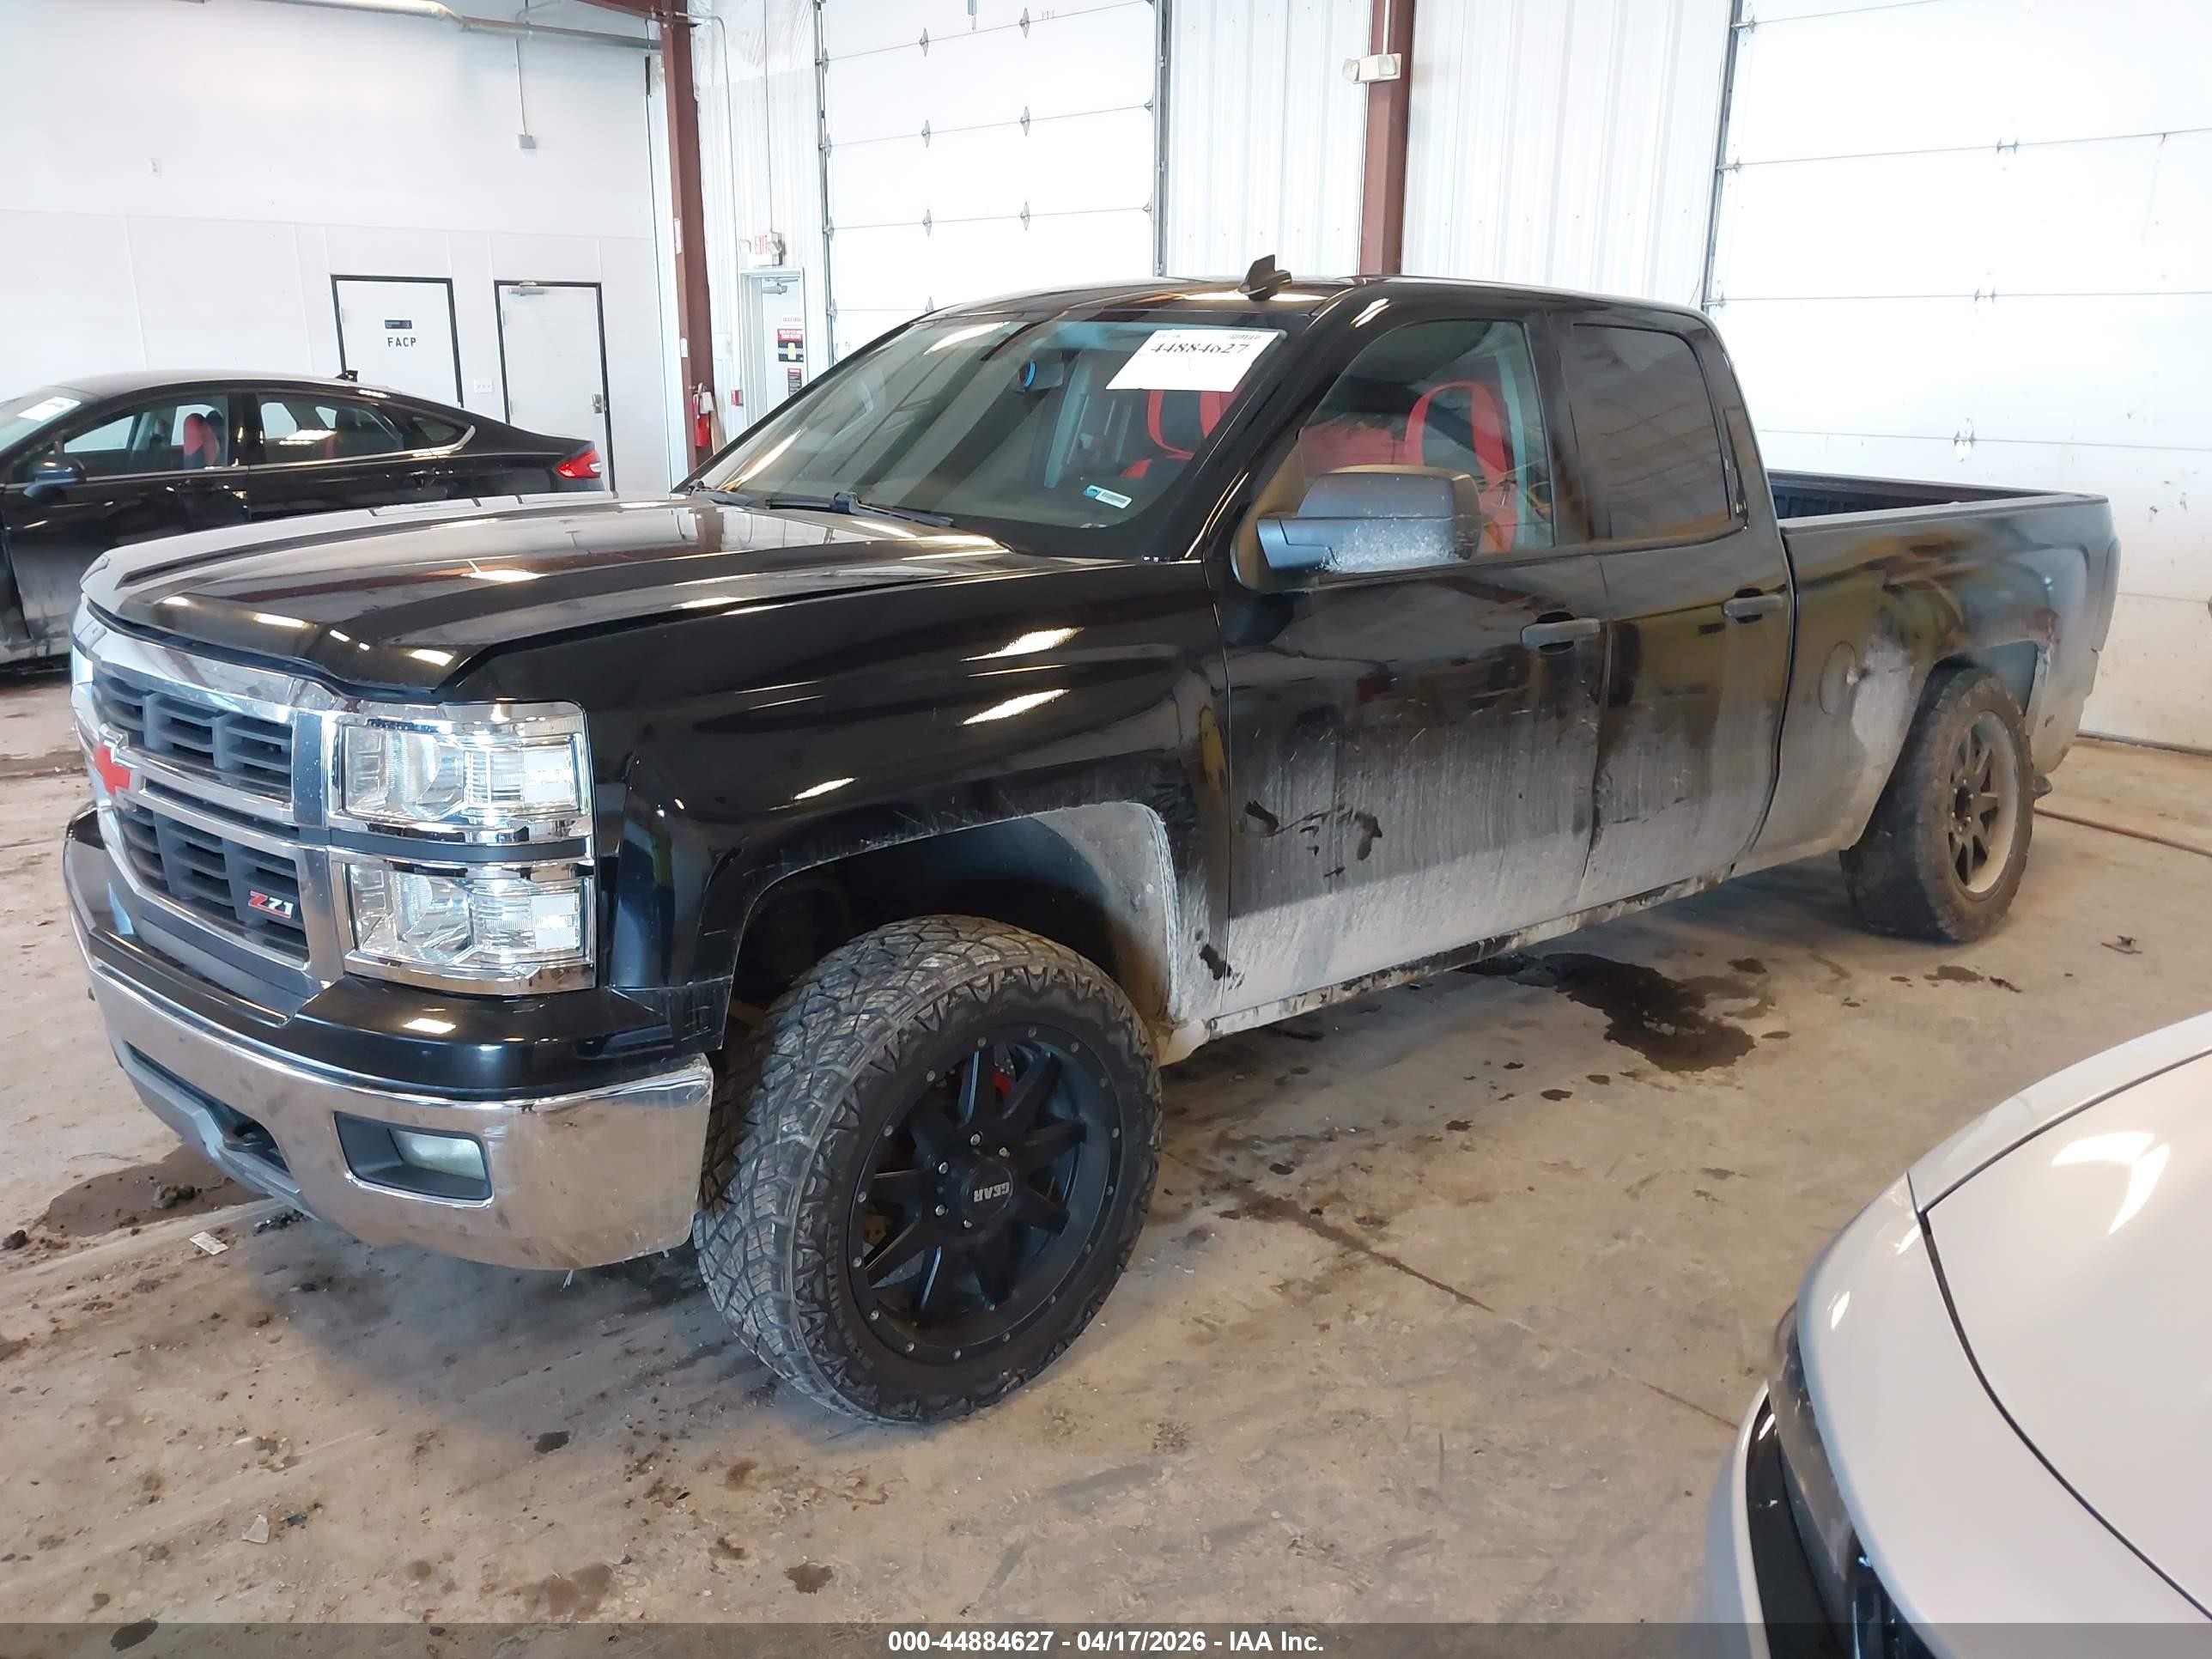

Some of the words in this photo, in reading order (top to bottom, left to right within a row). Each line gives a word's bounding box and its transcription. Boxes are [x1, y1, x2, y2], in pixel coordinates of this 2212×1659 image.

[387, 337, 416, 348] FACP
[248, 890, 294, 919] Z71
[974, 1182, 1010, 1202] GEAR
